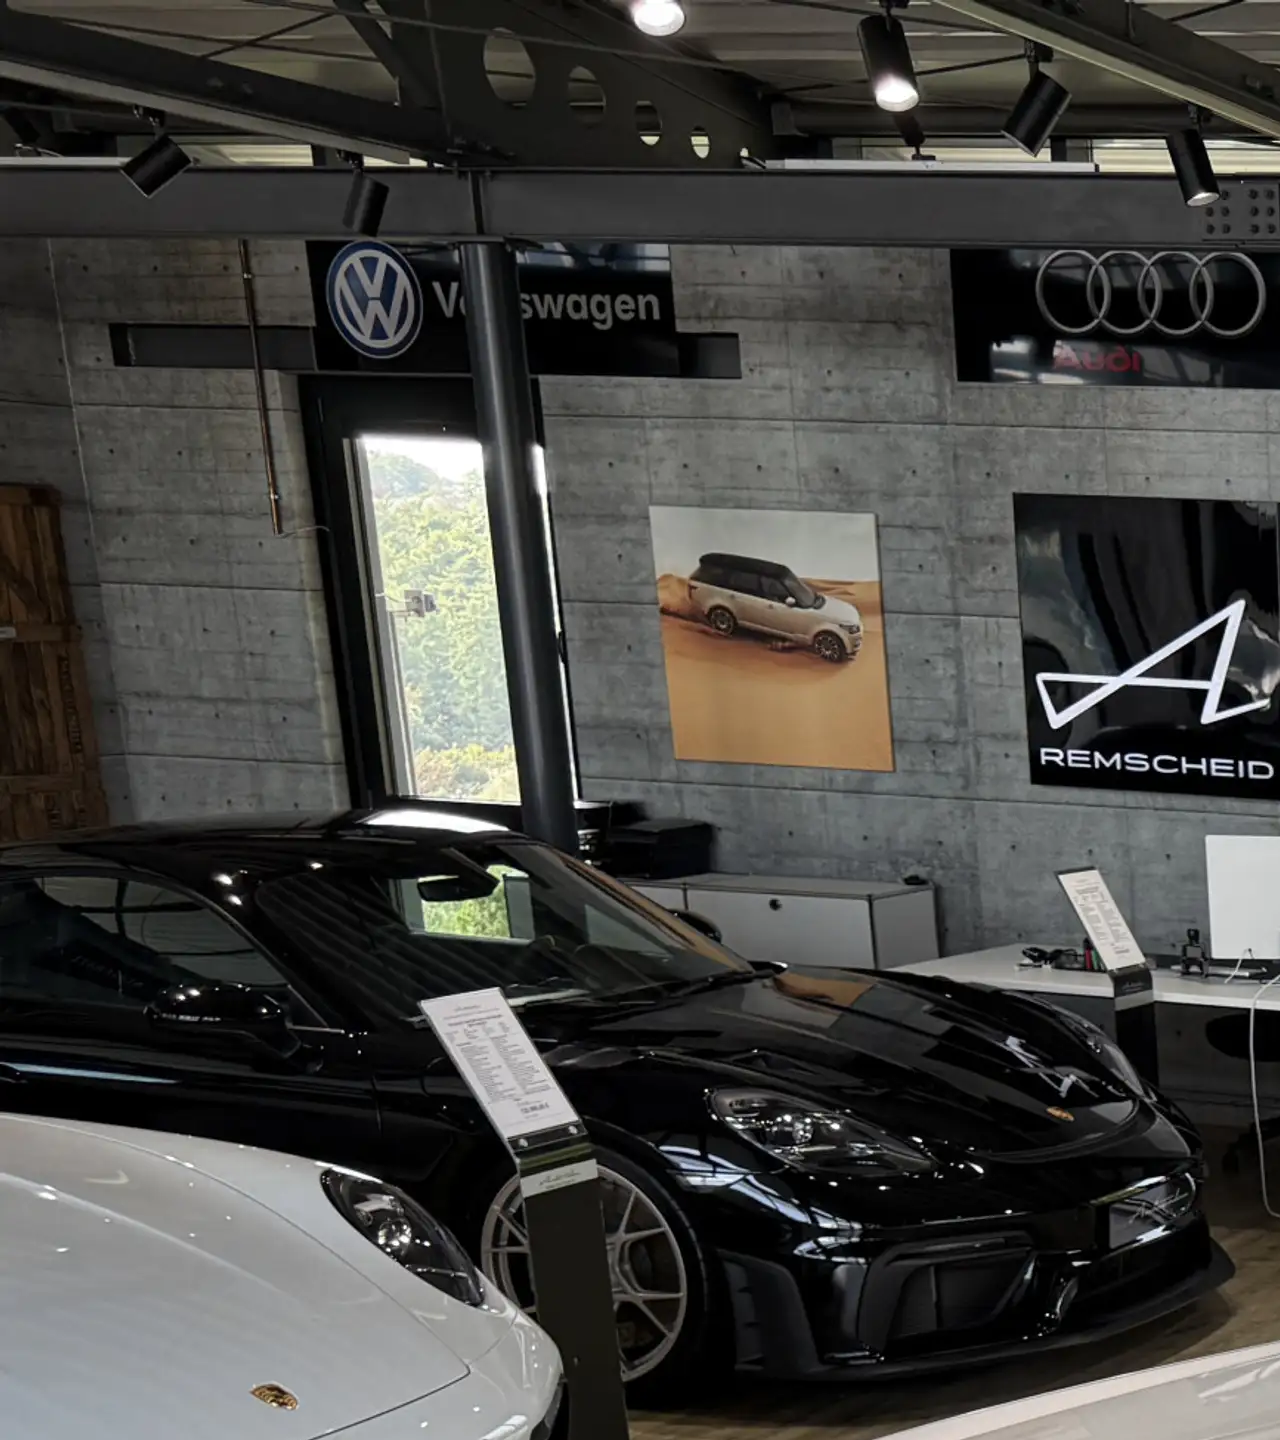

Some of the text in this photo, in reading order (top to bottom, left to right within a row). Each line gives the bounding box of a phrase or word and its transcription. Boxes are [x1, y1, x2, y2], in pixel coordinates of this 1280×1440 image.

[432, 278, 661, 331] Vswagen
[1052, 345, 1141, 374] Audi
[1039, 747, 1275, 780] REMSCHEID
